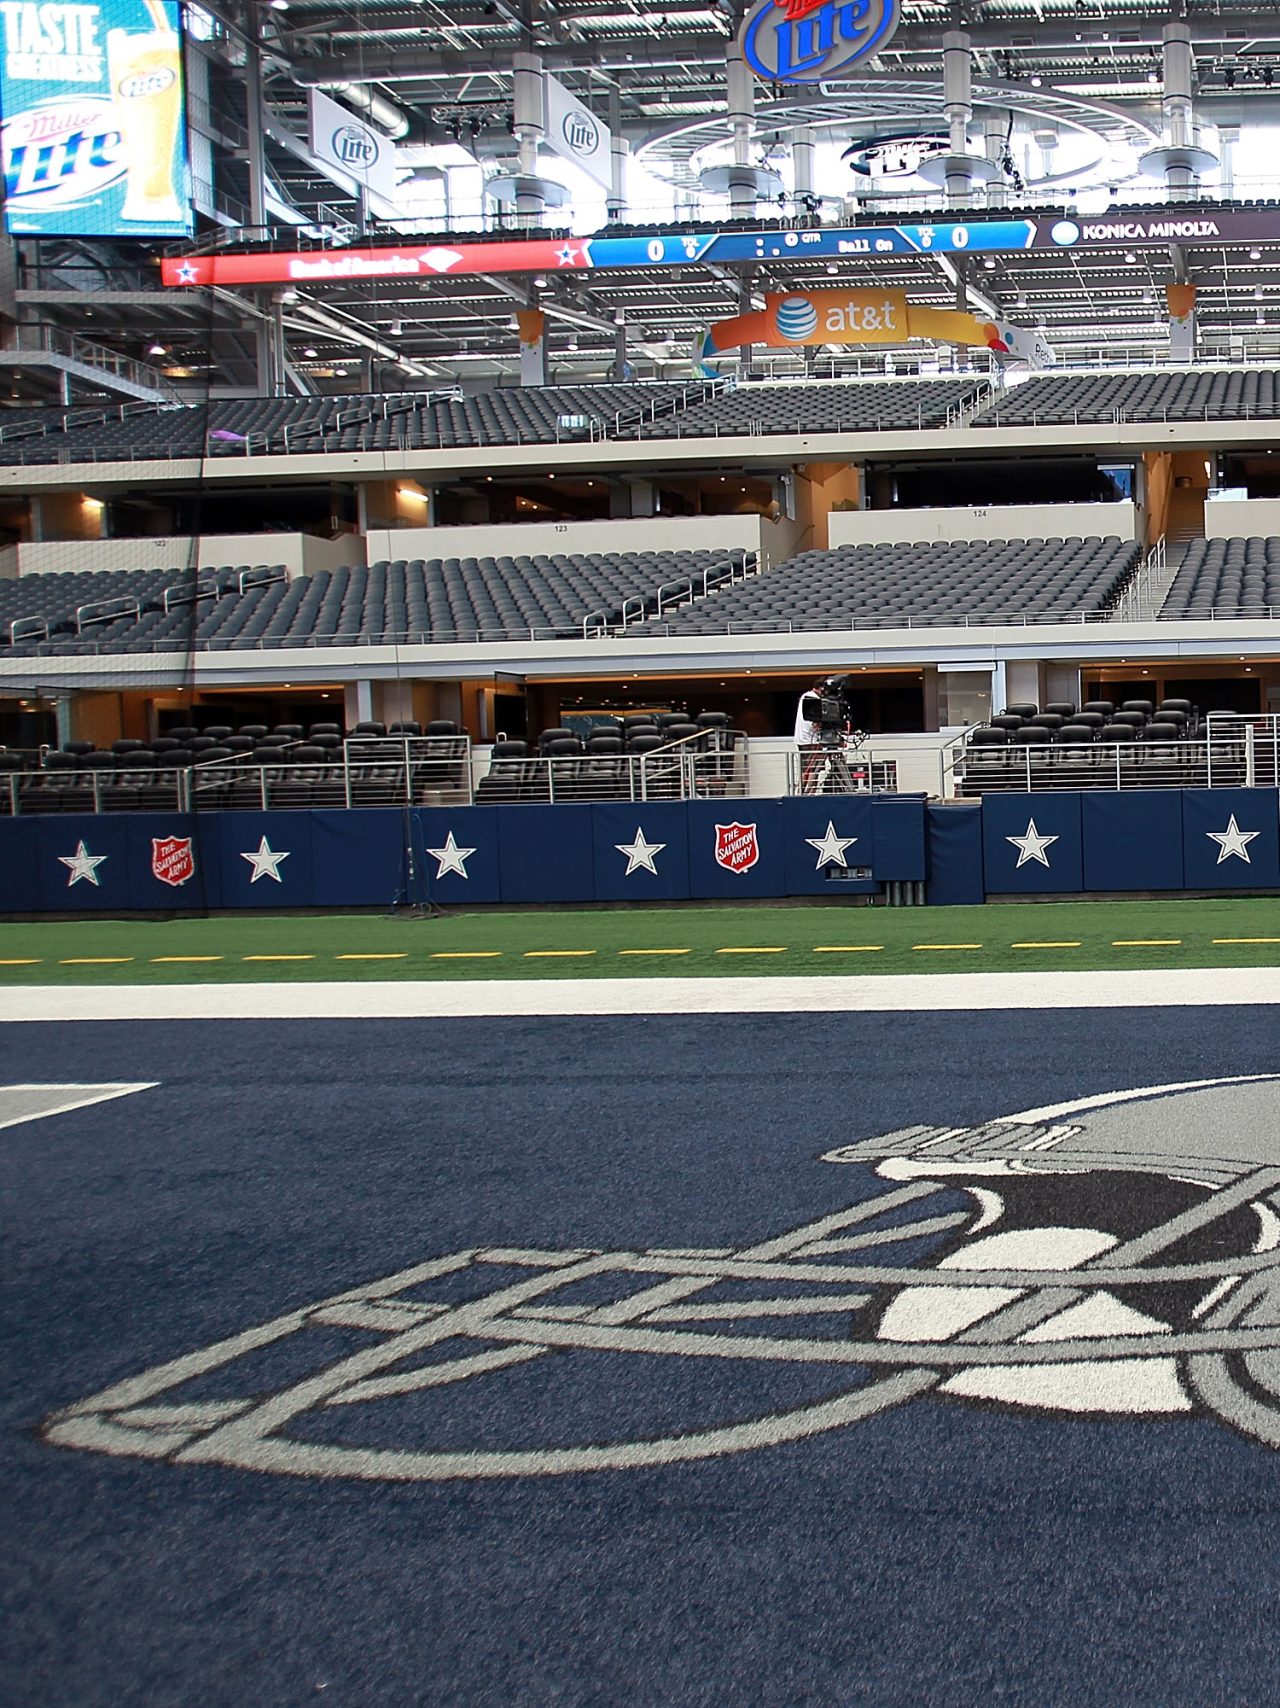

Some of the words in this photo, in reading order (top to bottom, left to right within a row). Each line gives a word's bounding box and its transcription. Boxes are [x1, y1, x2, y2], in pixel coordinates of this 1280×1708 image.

[1, 3, 101, 54] TASTE
[773, 0, 870, 79] Lite
[570, 123, 594, 149] Lite
[342, 138, 372, 163] Lite
[6, 131, 121, 198] Lite
[785, 233, 799, 246] 0
[952, 227, 969, 248] 0
[1082, 223, 1147, 241] KONICA
[1149, 221, 1220, 239] MINOLTA
[648, 240, 664, 261] 0
[825, 302, 896, 332] at&t
[718, 830, 753, 861] SALVATION
[723, 828, 740, 844] THE
[160, 841, 176, 857] THE
[731, 843, 753, 867] ARMY
[168, 856, 188, 880] ARMY
